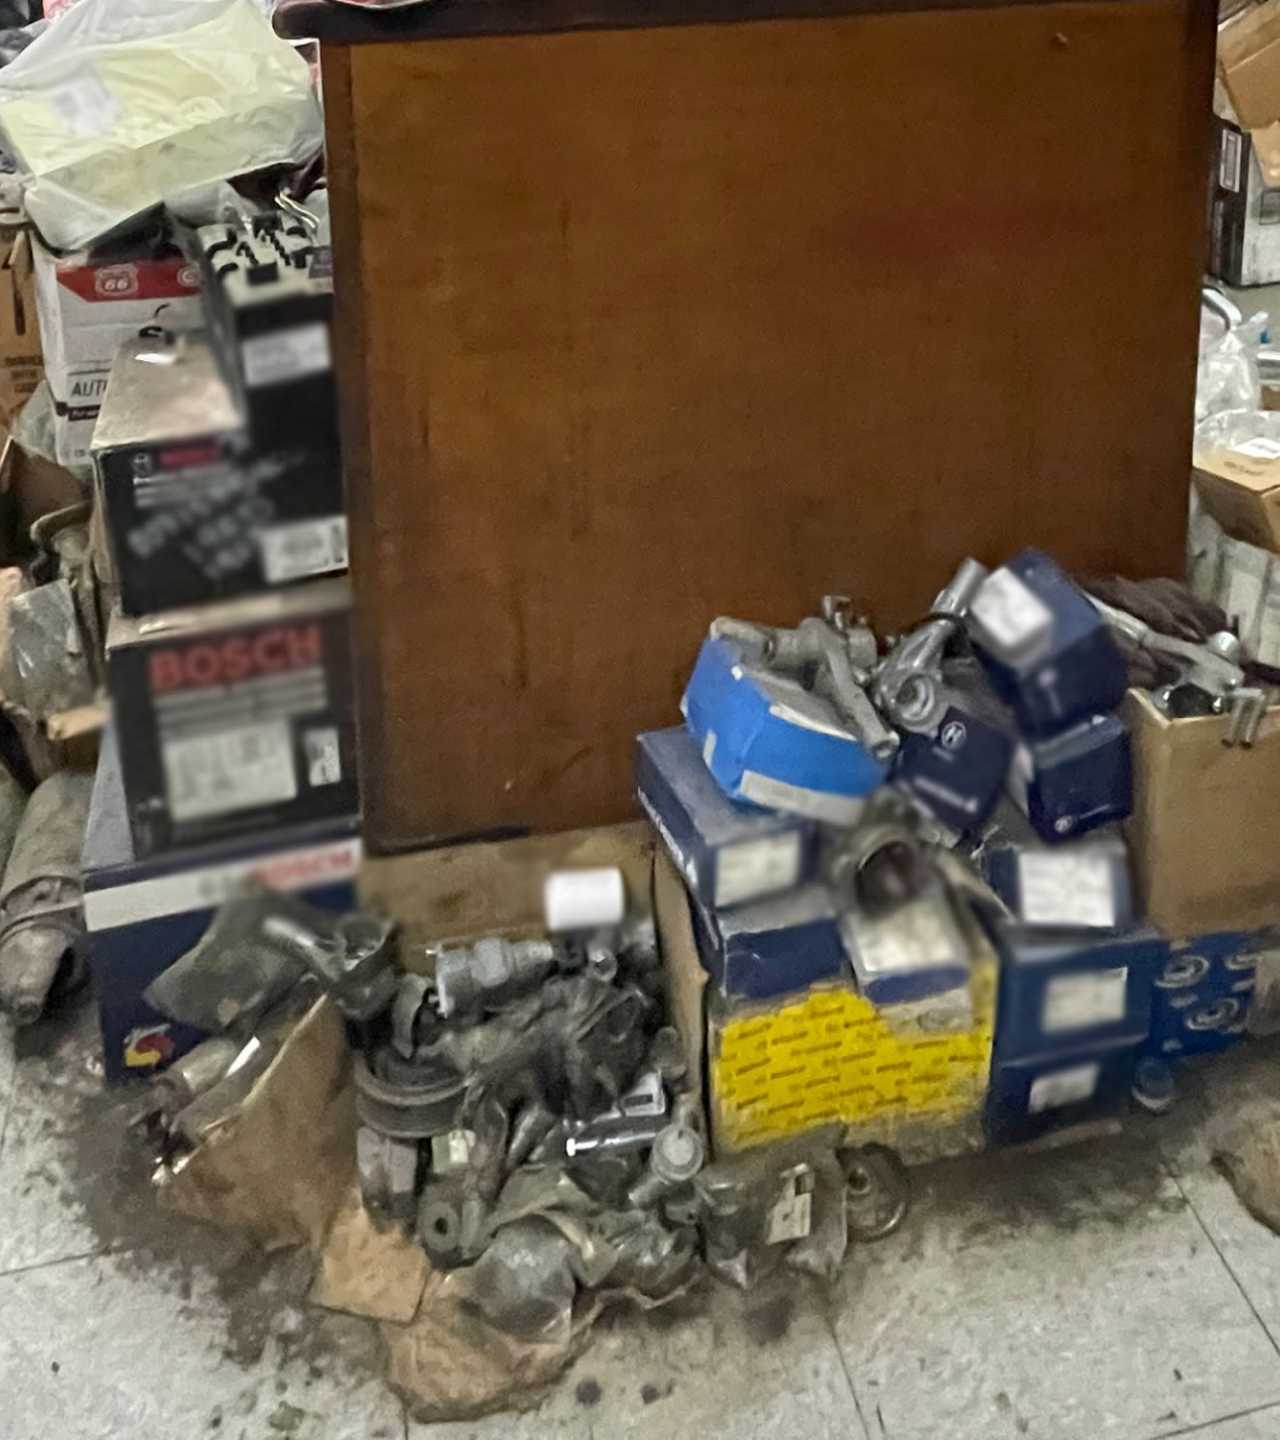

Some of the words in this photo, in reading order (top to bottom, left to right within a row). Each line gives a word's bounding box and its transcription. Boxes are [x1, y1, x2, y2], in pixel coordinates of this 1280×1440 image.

[104, 278, 129, 291] 66
[71, 379, 109, 397] AUT
[150, 625, 323, 694] BOSCH
